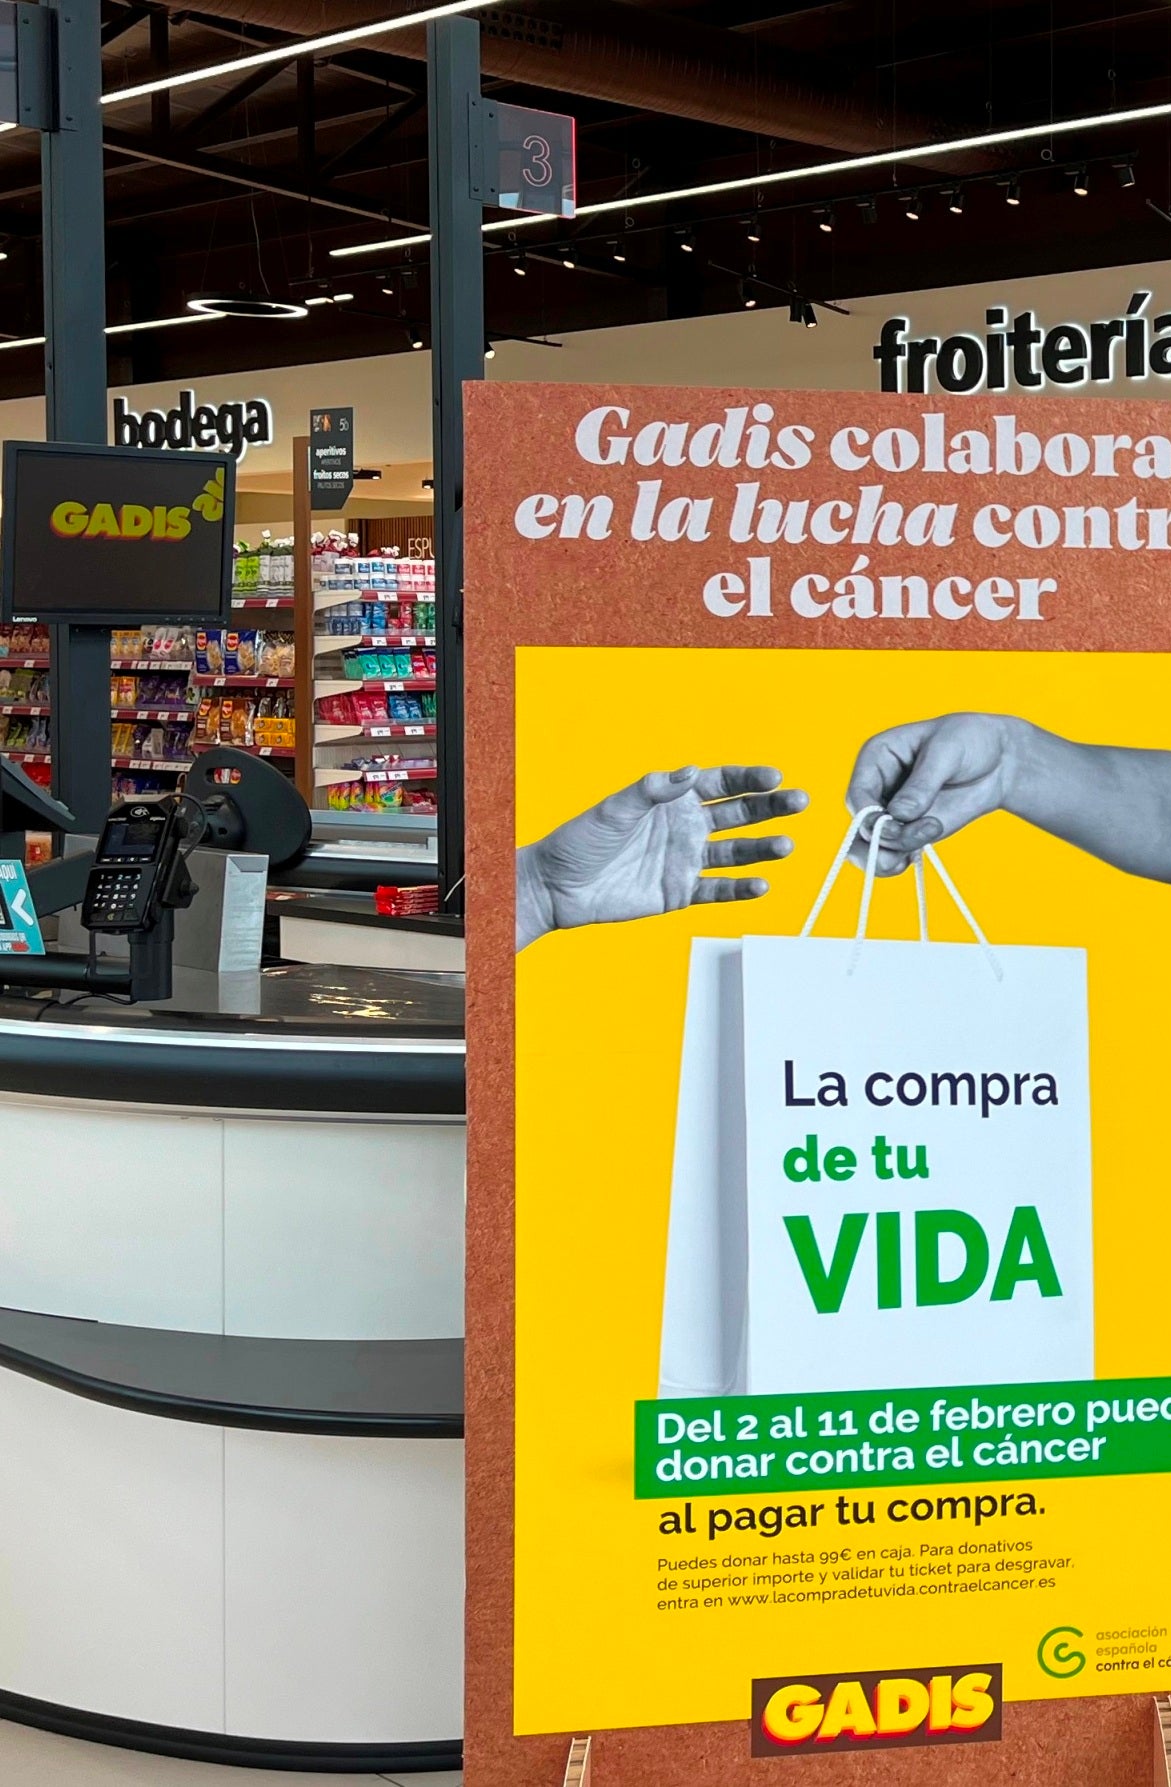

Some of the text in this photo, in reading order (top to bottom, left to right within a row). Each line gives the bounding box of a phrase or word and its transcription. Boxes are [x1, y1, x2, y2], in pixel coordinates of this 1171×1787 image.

[522, 135, 552, 187] 3
[113, 390, 272, 455] bodega
[575, 403, 816, 470] Gadis
[315, 446, 347, 459] aperitivos
[333, 470, 349, 480] secos
[50, 500, 191, 541] GADIS
[513, 493, 615, 540] en
[630, 480, 714, 543] la
[728, 481, 959, 546] lucha
[702, 553, 1057, 622] el cáncer
[784, 1060, 1058, 1118] La compra
[783, 1134, 929, 1182] de tu
[782, 1205, 1063, 1314] VIDA
[657, 1410, 726, 1444] Del
[736, 1414, 758, 1440] 2
[769, 1406, 807, 1439] al
[817, 1410, 858, 1436] 11
[868, 1402, 920, 1434] de
[929, 1398, 1076, 1431] febrero
[656, 1433, 1107, 1482] donar contra el cáncer
[658, 1493, 1046, 1540] al pagar tu compra.
[657, 1539, 1033, 1571] Puedes donar hasta 99€ en caja. Para donativos
[657, 1556, 1075, 1591] de superior importe y validar tu ticket para desgravar.
[657, 1576, 1056, 1610] entra en www.lacompradetuvida.contraelcancer.es
[1096, 1626, 1168, 1641] asociación
[1096, 1642, 1158, 1658] española
[1096, 1658, 1140, 1672] contra
[1143, 1657, 1155, 1669] el
[761, 1672, 994, 1747] GADIS
